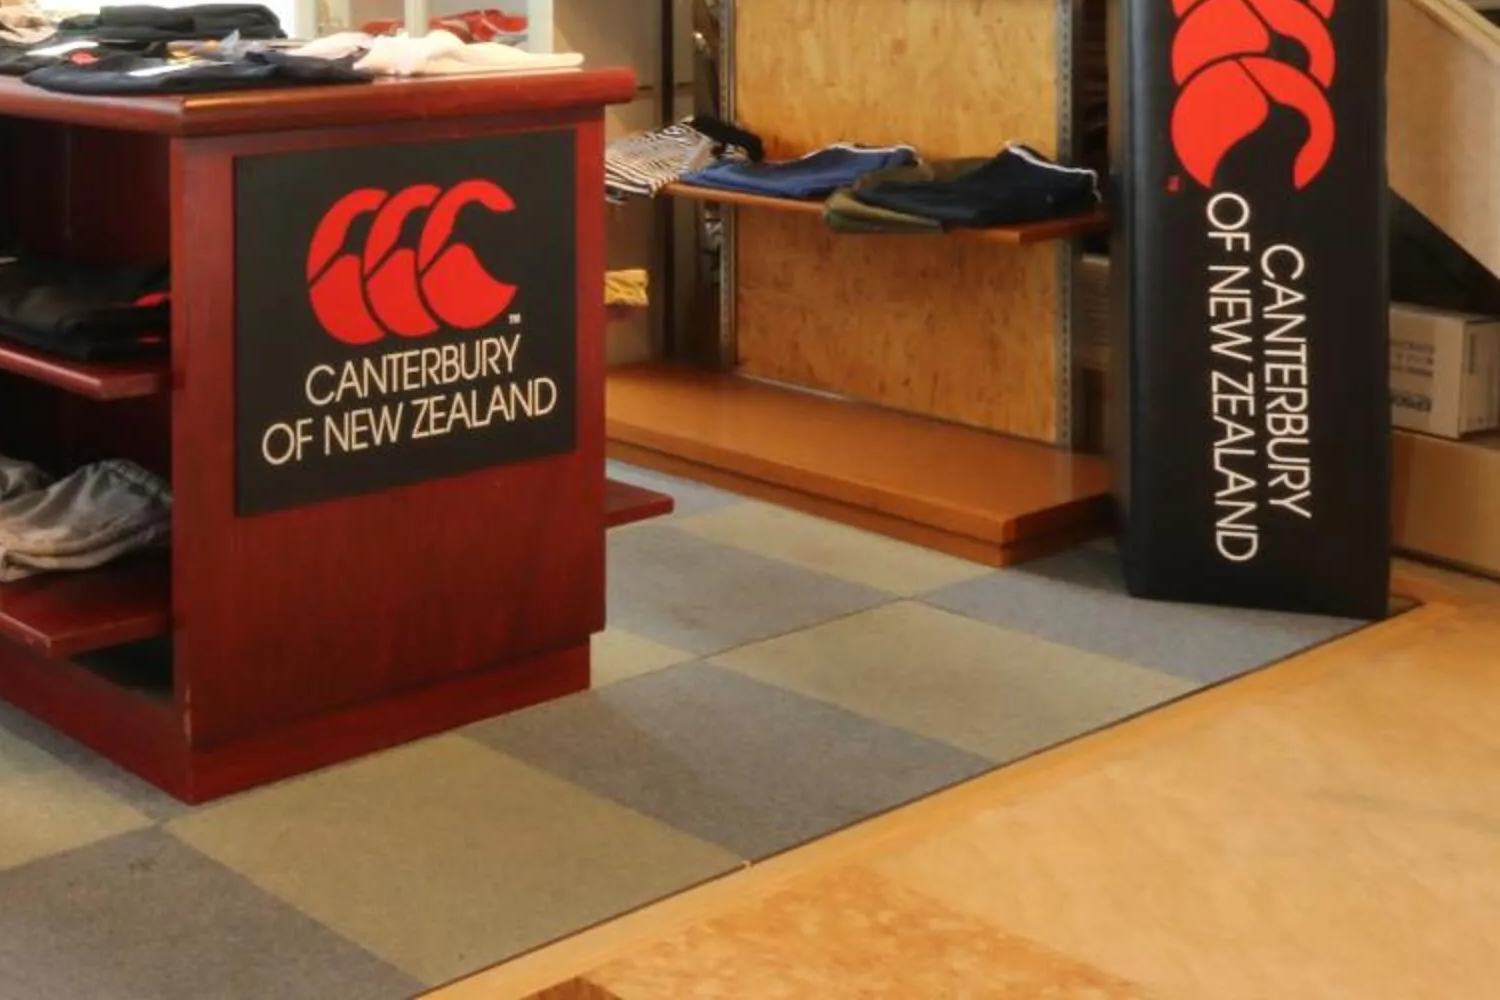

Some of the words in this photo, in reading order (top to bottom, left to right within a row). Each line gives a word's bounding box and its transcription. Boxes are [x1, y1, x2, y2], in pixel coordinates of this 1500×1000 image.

[1206, 192, 1251, 252] OF
[1208, 265, 1253, 362] NEW
[305, 334, 521, 405] CANTERBURY
[1260, 244, 1312, 519] CANTERBURY
[261, 418, 313, 466] OF
[324, 402, 404, 456] NEW
[411, 376, 558, 440] ZEALAND
[1211, 372, 1258, 562] ZEALAND
